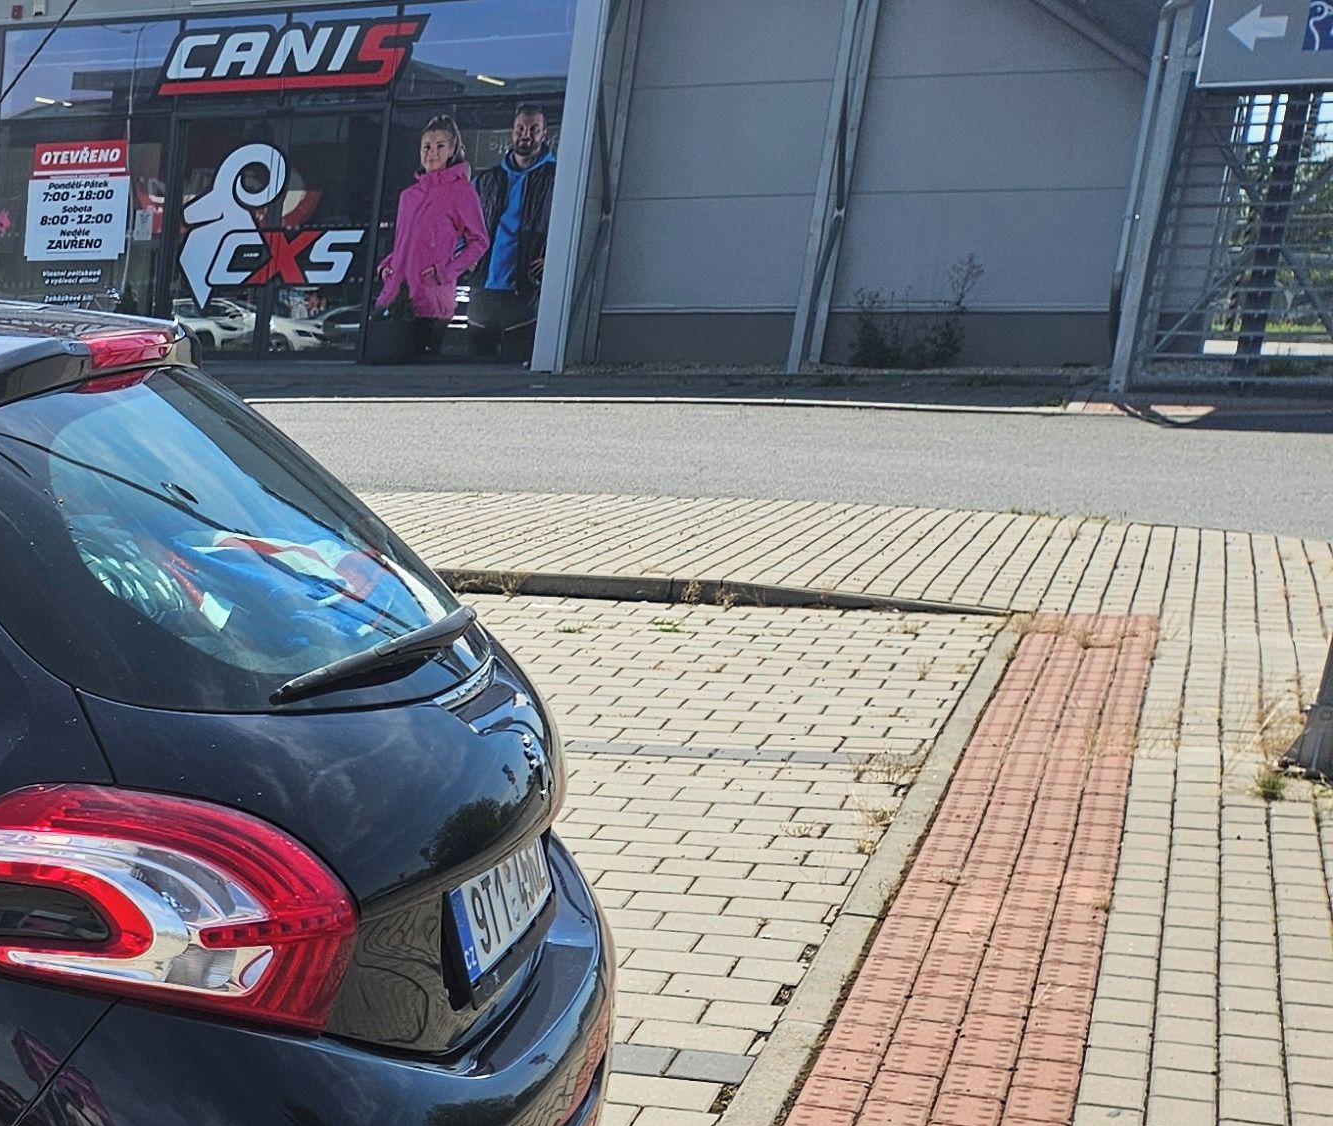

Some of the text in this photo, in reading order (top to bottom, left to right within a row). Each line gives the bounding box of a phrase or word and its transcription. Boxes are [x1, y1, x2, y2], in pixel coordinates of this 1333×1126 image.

[166, 22, 420, 84] CANIS
[40, 147, 121, 165] OTEVŘENO
[42, 191, 70, 202] 7:00
[77, 189, 114, 201] 18:00
[62, 205, 93, 214] Sobota
[40, 215, 69, 226] 8:00
[76, 213, 113, 225] 12:00
[59, 229, 91, 238] Neděle
[46, 237, 103, 250] ZAVŘENO
[207, 229, 366, 285] CXS
[470, 866, 513, 954] 9T1
[464, 946, 478, 971] CZ
